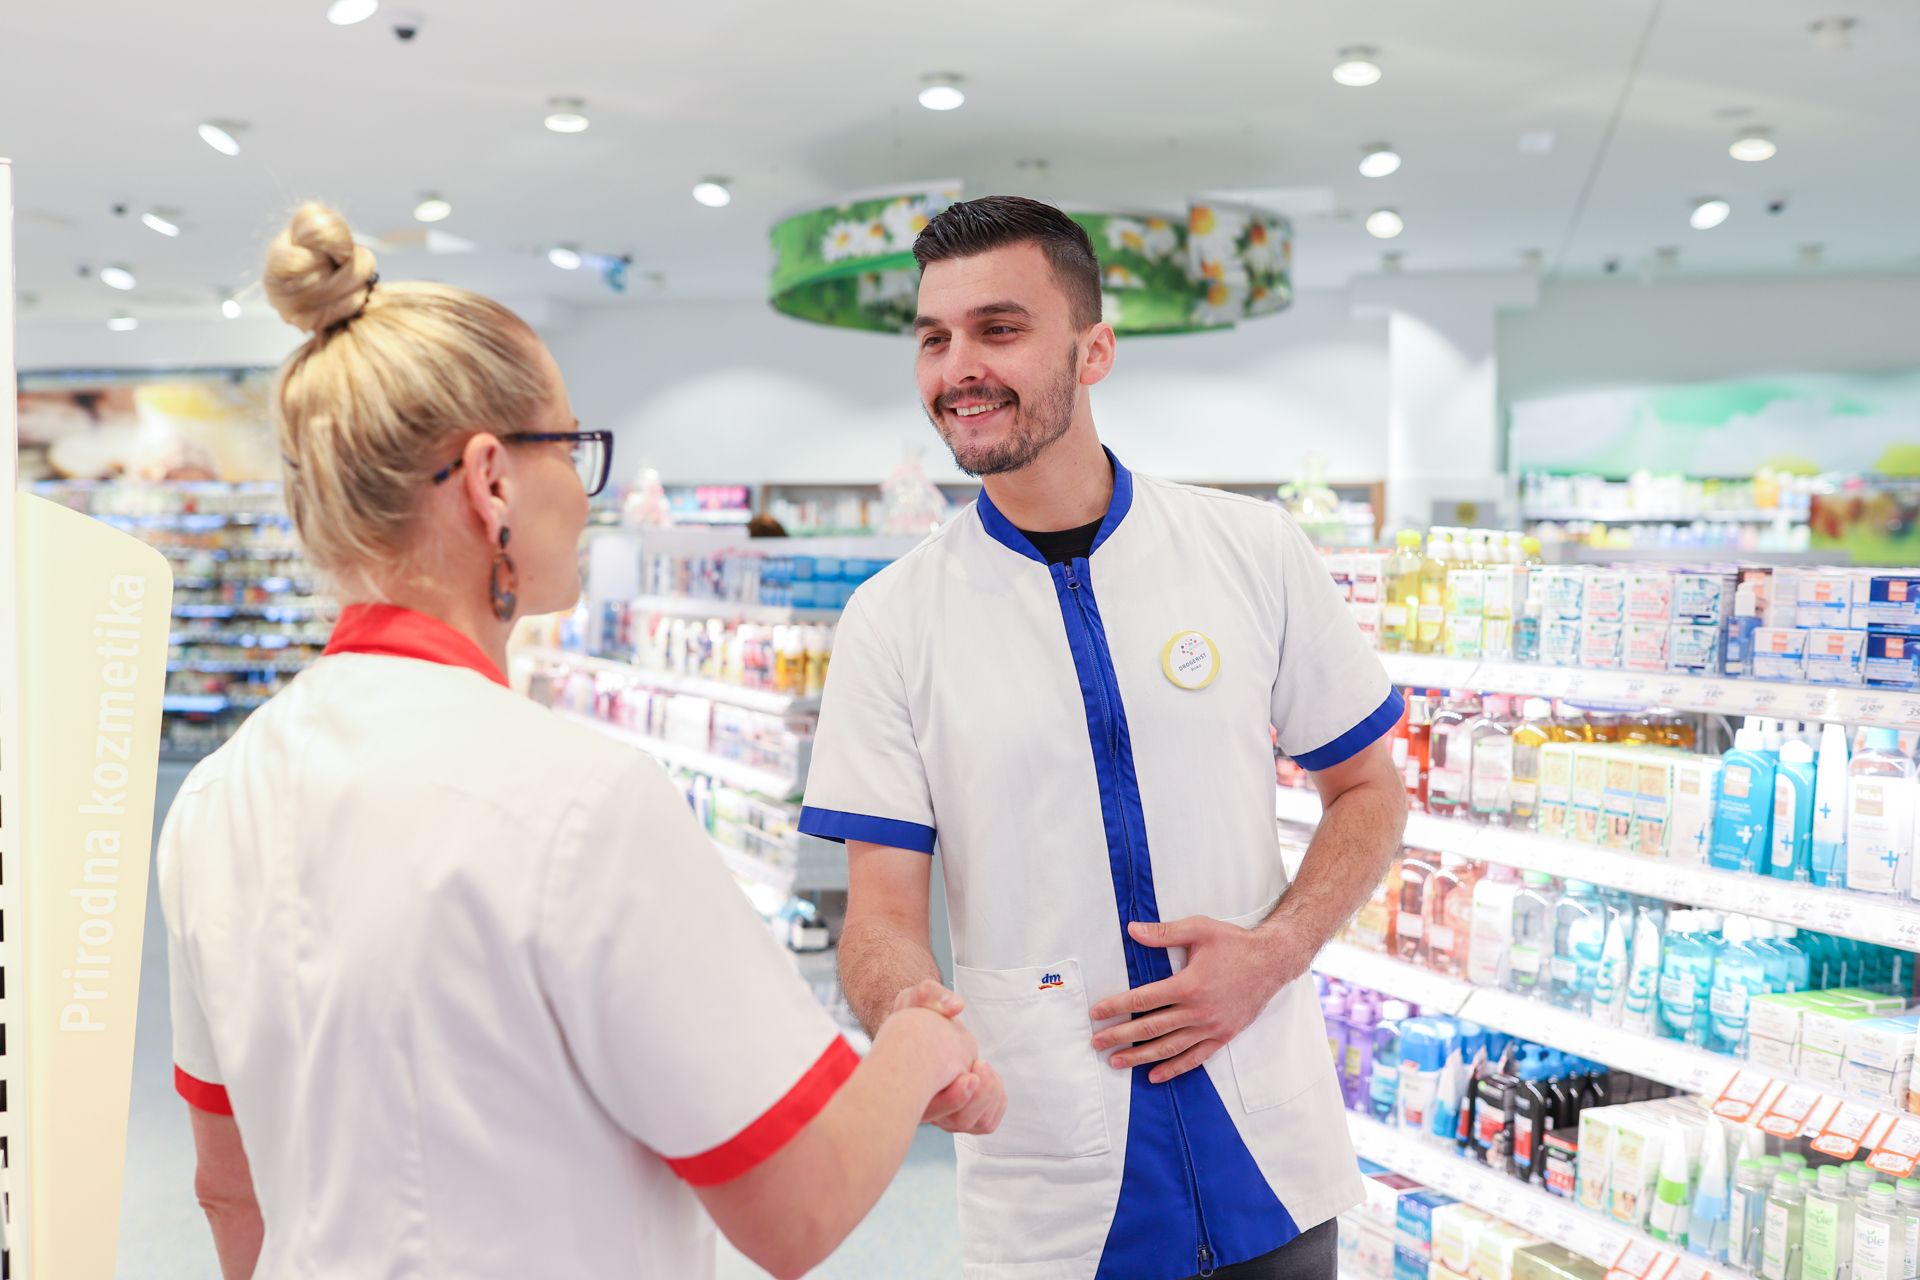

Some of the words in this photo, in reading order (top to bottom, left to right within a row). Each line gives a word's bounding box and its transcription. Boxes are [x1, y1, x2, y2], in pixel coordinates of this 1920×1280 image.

[78, 573, 146, 815] kozmetika
[1178, 652, 1207, 671] DROGERIST
[59, 828, 121, 1032] Prirodna
[1041, 973, 1061, 984] dm
